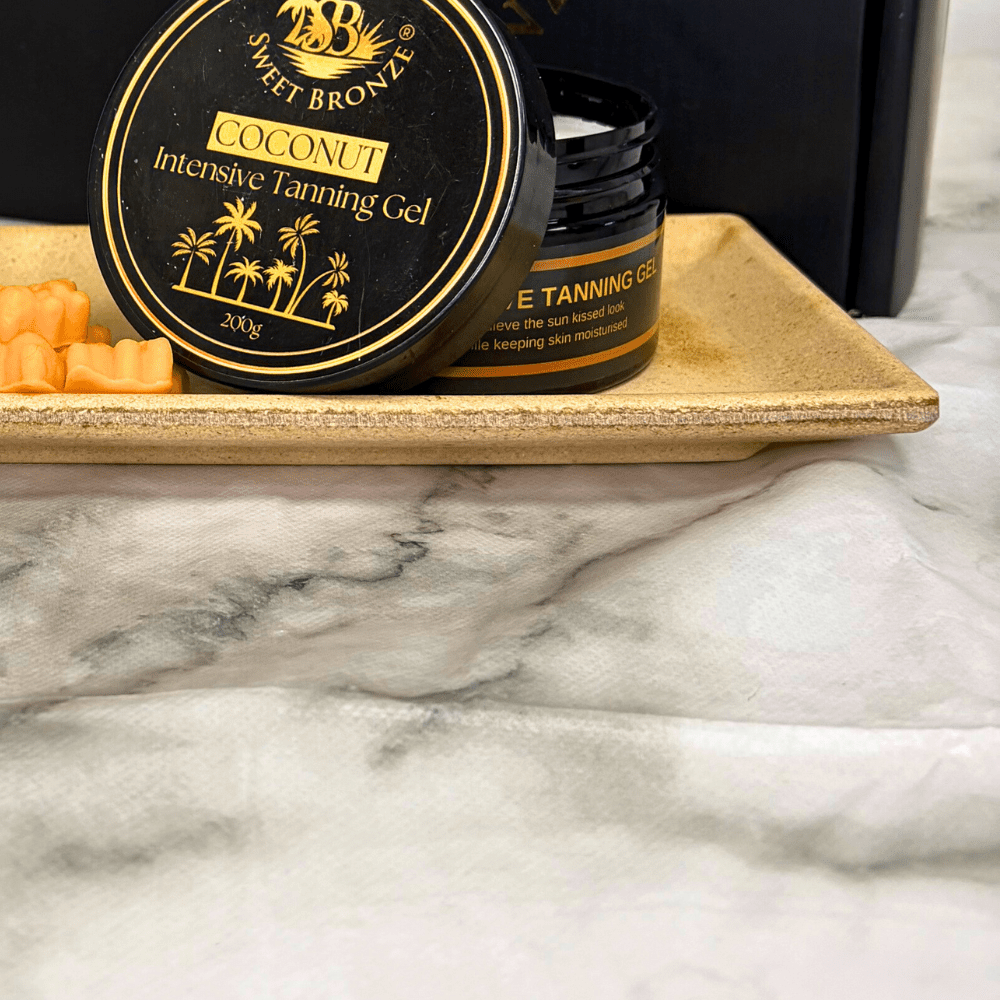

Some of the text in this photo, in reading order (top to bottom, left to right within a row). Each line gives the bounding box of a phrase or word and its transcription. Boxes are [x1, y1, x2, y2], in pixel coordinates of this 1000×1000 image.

[249, 32, 415, 111] SWEET BRONZE
[215, 119, 383, 174] COCONUT
[153, 146, 433, 225] Intensive Tanning Gel
[541, 269, 633, 307] TANNING
[636, 256, 657, 284] GEL
[220, 312, 264, 340] 200g
[489, 300, 625, 332] ieve the sun kissed look
[493, 336, 545, 352] keeping
[547, 332, 572, 346] skin
[574, 316, 628, 342] moisturised
